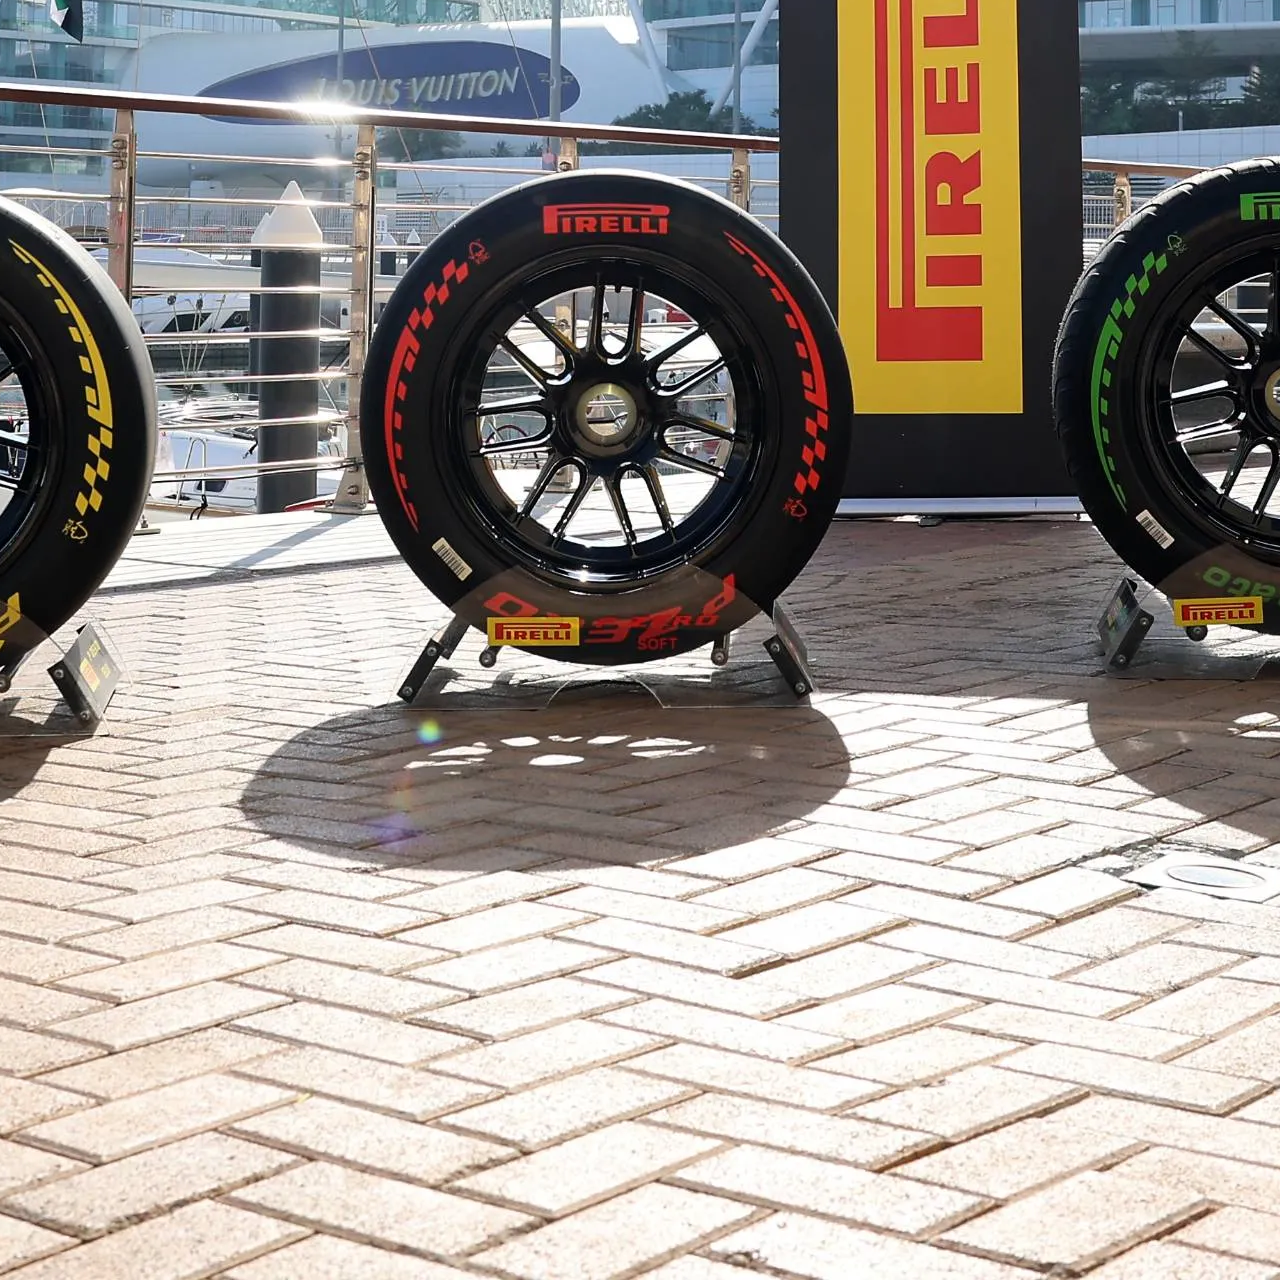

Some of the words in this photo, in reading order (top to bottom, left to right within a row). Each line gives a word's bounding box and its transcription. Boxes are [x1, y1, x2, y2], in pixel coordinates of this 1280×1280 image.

[316, 78, 401, 106] LOUIS
[411, 66, 519, 104] VUITTON
[542, 203, 671, 235] PIRELLI
[1181, 602, 1255, 621] PIRELLI
[495, 622, 571, 640] PIRELLI
[638, 637, 678, 650] SOFT
